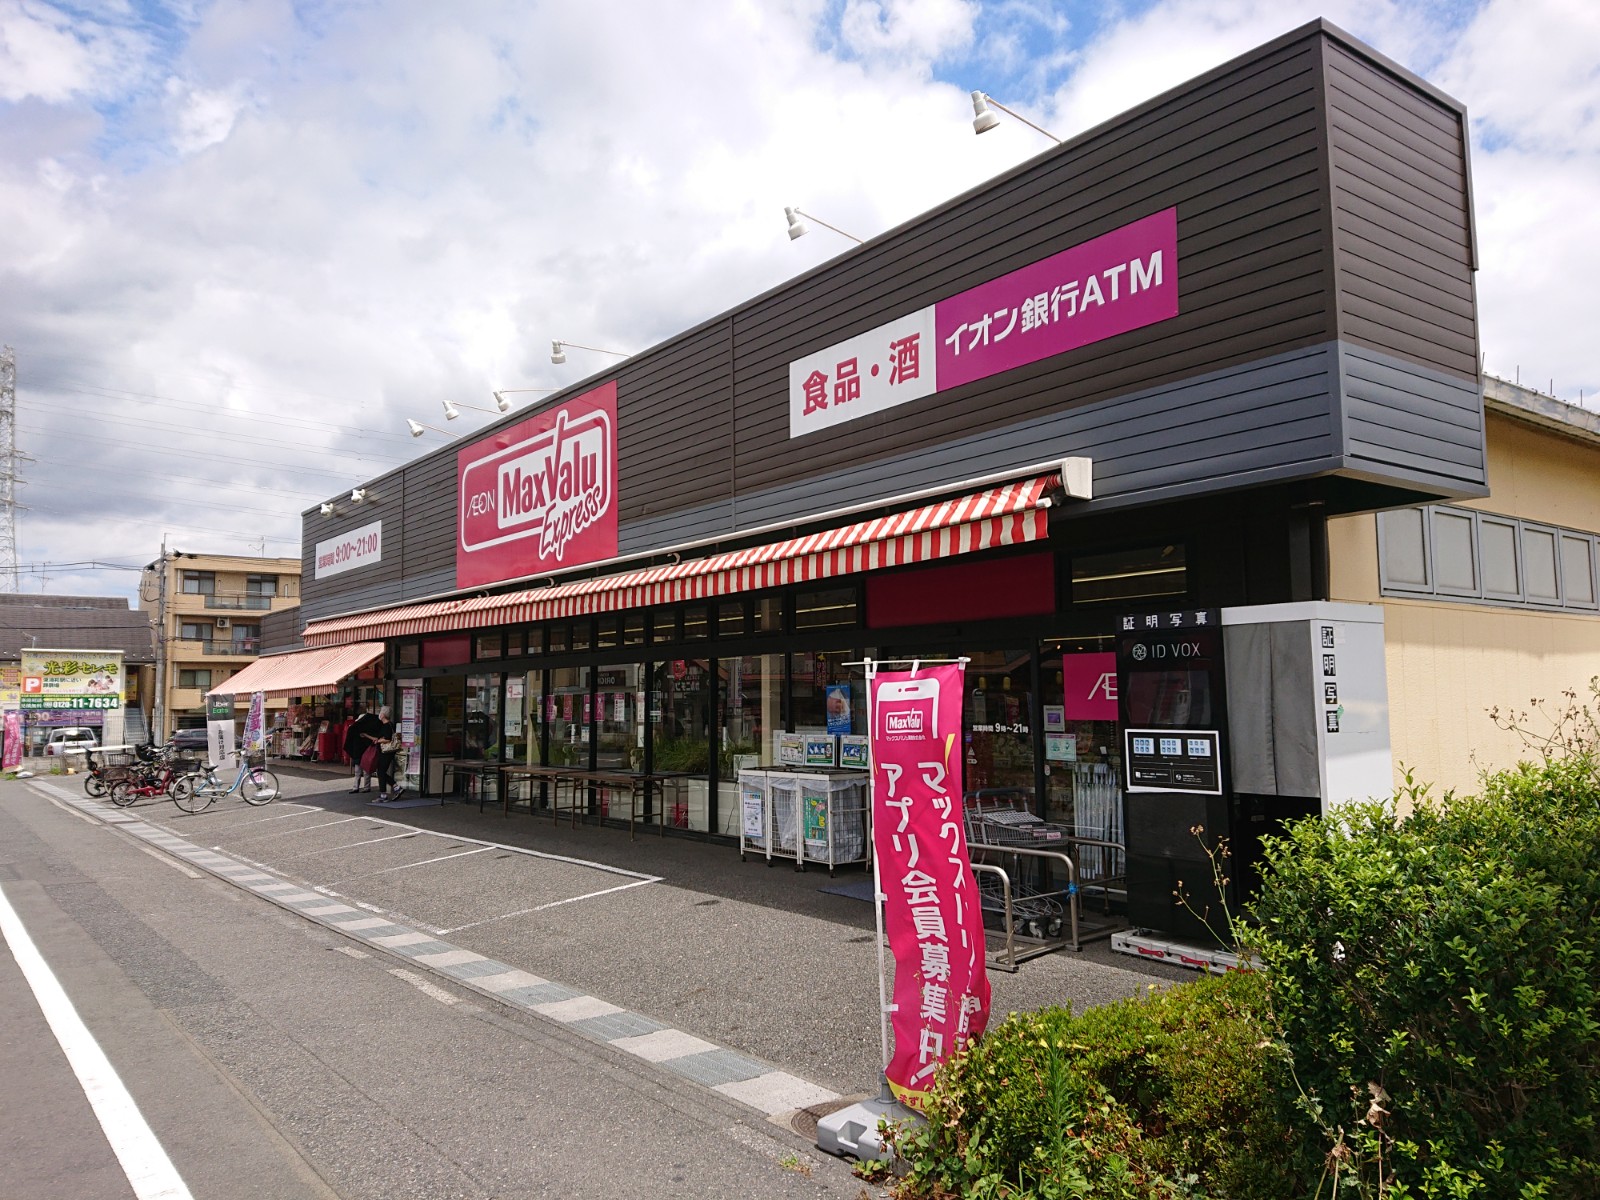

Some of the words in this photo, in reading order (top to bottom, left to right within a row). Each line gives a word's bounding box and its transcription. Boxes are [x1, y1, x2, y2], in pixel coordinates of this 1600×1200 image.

[945, 250, 1163, 356] イオン銀行ATM
[802, 332, 921, 417] 食品・酒
[502, 415, 597, 519] MaxValu
[541, 484, 601, 554] Express
[1122, 611, 1208, 630] 証明写真
[1151, 644, 1166, 658] ID
[1171, 642, 1201, 658] VOX
[1321, 626, 1338, 732] 証明写真
[888, 708, 921, 730] MaxValu
